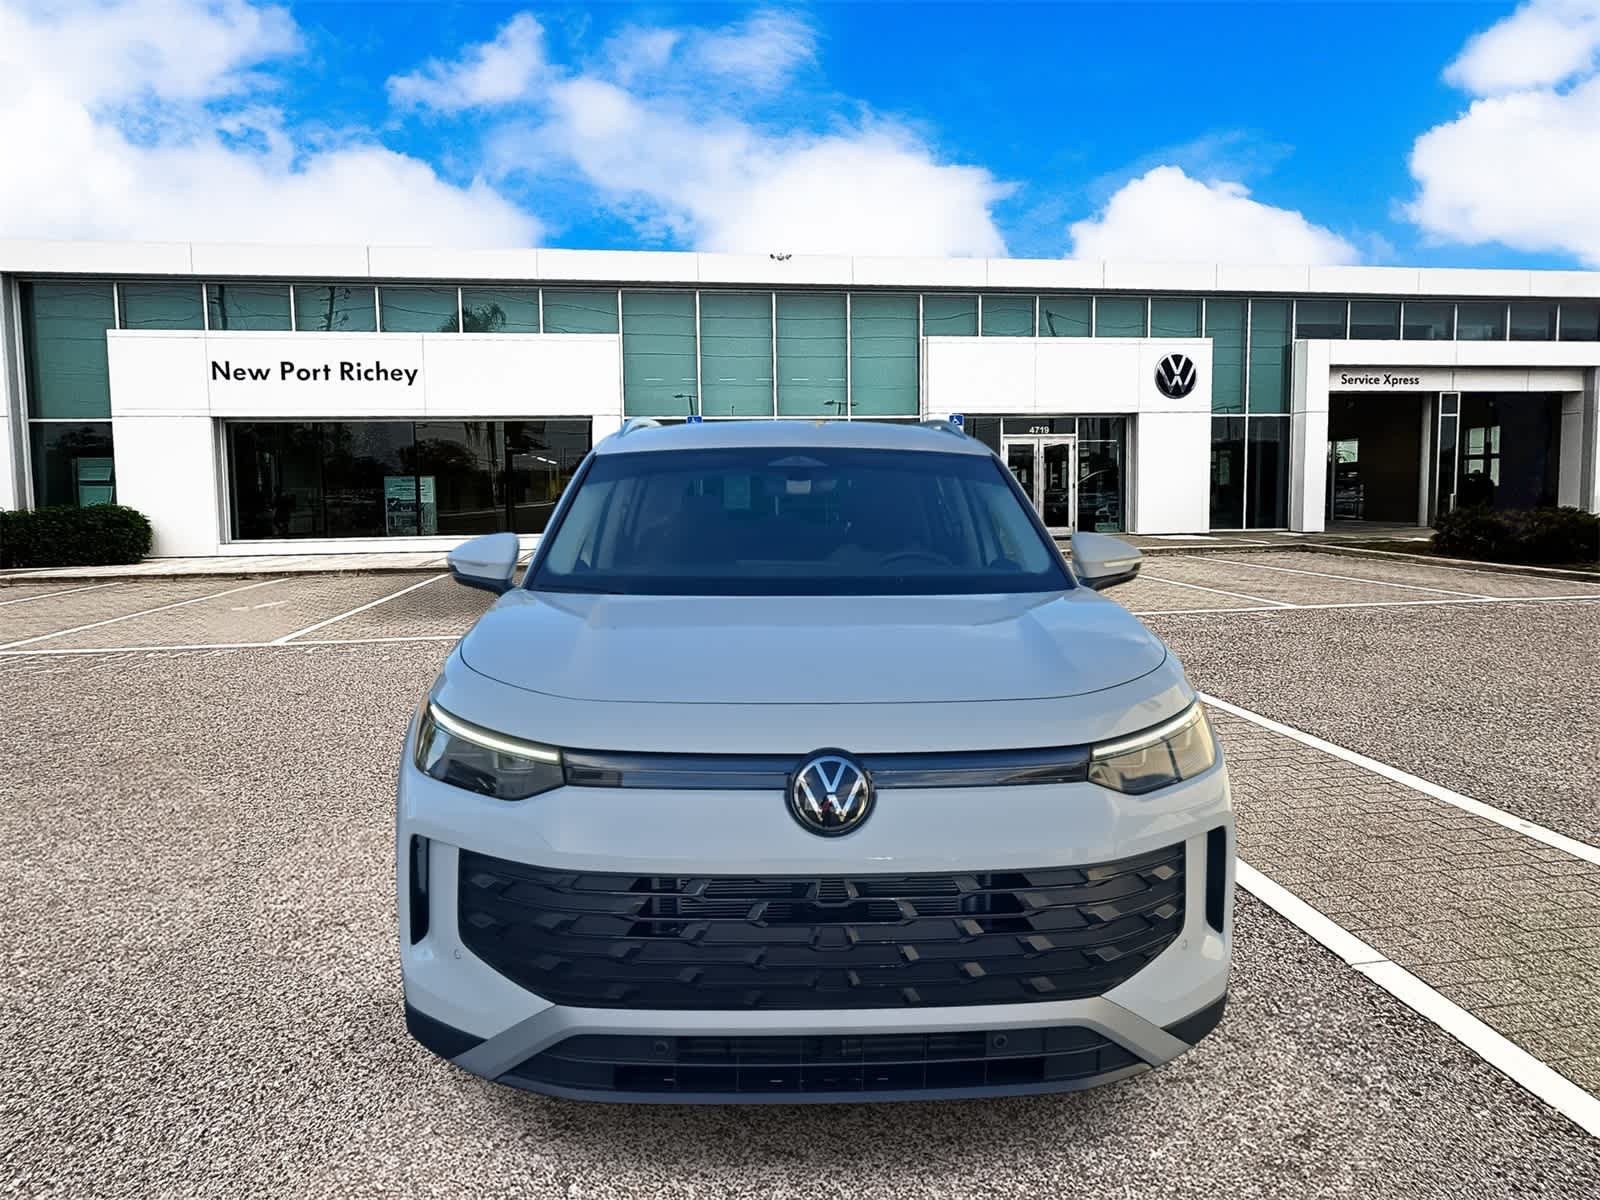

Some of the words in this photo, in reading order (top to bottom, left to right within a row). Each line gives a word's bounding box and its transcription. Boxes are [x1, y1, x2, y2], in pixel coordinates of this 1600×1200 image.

[211, 361, 271, 381] New
[280, 361, 331, 381] Port
[340, 361, 419, 386] Richey
[1341, 374, 1380, 385] Service
[1383, 374, 1420, 388] Xpress
[1029, 426, 1050, 434] 4719
